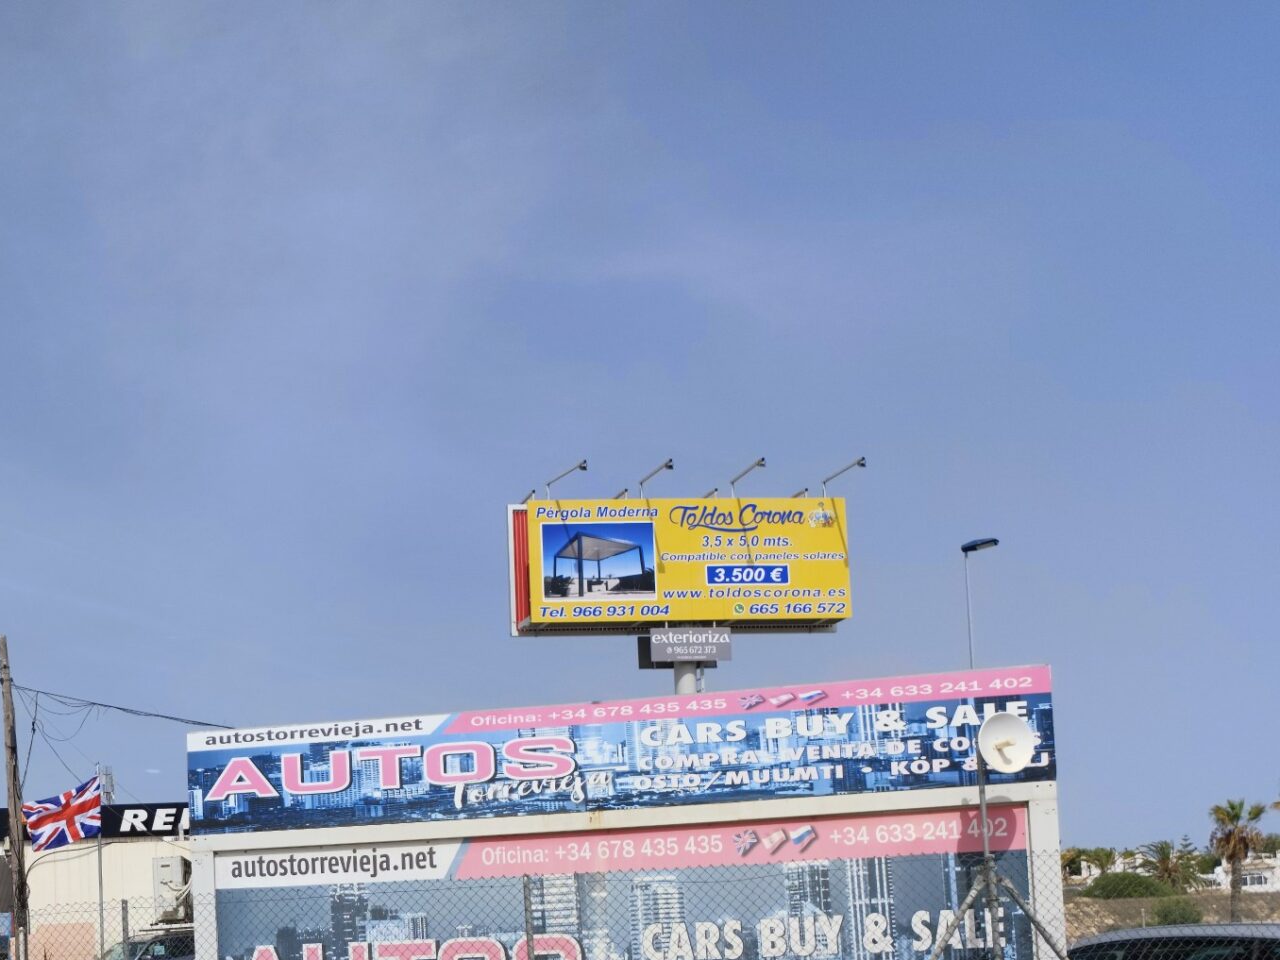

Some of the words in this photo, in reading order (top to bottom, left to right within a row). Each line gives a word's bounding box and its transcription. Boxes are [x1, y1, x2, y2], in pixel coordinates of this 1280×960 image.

[536, 507, 591, 521] Pérgola
[596, 506, 658, 518] Moderna
[669, 504, 734, 531] Toldos
[738, 503, 805, 527] Corona
[702, 535, 722, 548] 3,5
[726, 538, 734, 547] x
[739, 535, 759, 548] 5,0
[763, 536, 793, 547] mts.
[660, 552, 727, 563] Compatible
[730, 553, 751, 561] con
[754, 552, 799, 562] paneles
[803, 551, 845, 560] solares
[714, 568, 765, 582] 3.500
[770, 568, 783, 582] €
[663, 587, 846, 598] www.toldoscorona.es
[540, 607, 567, 617] Tel.
[573, 606, 602, 617] 966
[607, 606, 635, 616] 931
[640, 605, 670, 616] 004
[749, 604, 779, 614] 665
[785, 603, 812, 614] 166
[816, 602, 846, 613] 572
[651, 630, 730, 644] exterioriza
[841, 687, 883, 701] +34
[890, 684, 933, 697] 633
[940, 680, 982, 694] 241
[989, 676, 1033, 690] 402
[471, 713, 542, 727] Oficina:
[548, 708, 586, 721] +34
[596, 705, 633, 718] 678
[639, 701, 680, 714] 435
[686, 698, 727, 711] 435
[205, 717, 423, 746] autostorrevieja.net
[641, 720, 747, 747] CARS
[765, 712, 854, 740] BUY
[874, 710, 908, 732] &
[638, 750, 759, 770] COMPRA
[785, 741, 877, 761] VENTA
[886, 739, 922, 755] DE
[890, 756, 951, 776] KÖP
[204, 736, 577, 802] AUTOS
[829, 826, 870, 846] +34
[875, 823, 916, 843] 633
[922, 820, 962, 841] 241
[967, 817, 1008, 838] 402
[231, 847, 437, 878] autostorrevieja.net
[481, 846, 549, 866] Oficina:
[554, 843, 592, 861] +34
[598, 840, 635, 858] 678
[641, 837, 679, 856] 435
[685, 834, 723, 854] 435
[759, 914, 844, 958] BUY
[863, 913, 896, 953] &
[911, 907, 1006, 951] SALE
